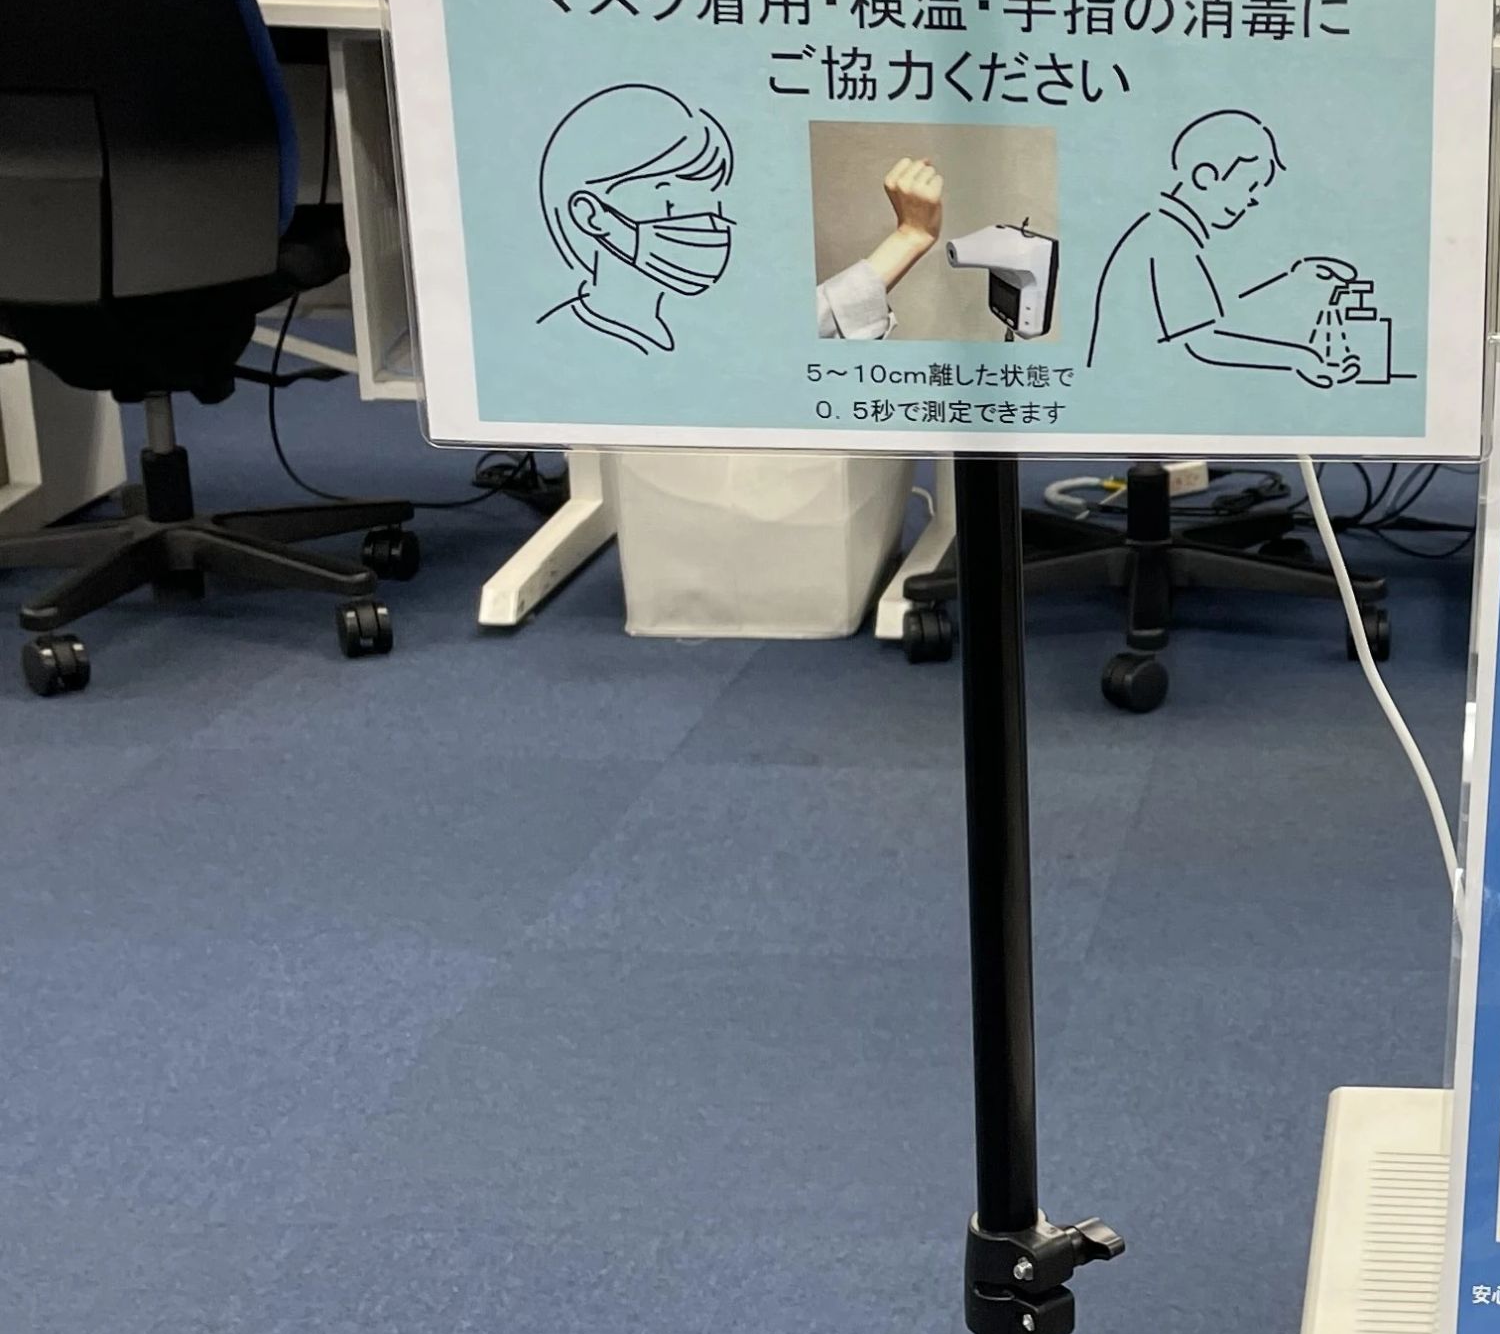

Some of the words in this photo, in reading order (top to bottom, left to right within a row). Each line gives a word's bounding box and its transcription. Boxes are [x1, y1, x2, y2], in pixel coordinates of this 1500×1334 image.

[766, 43, 1131, 106] ご協力ください
